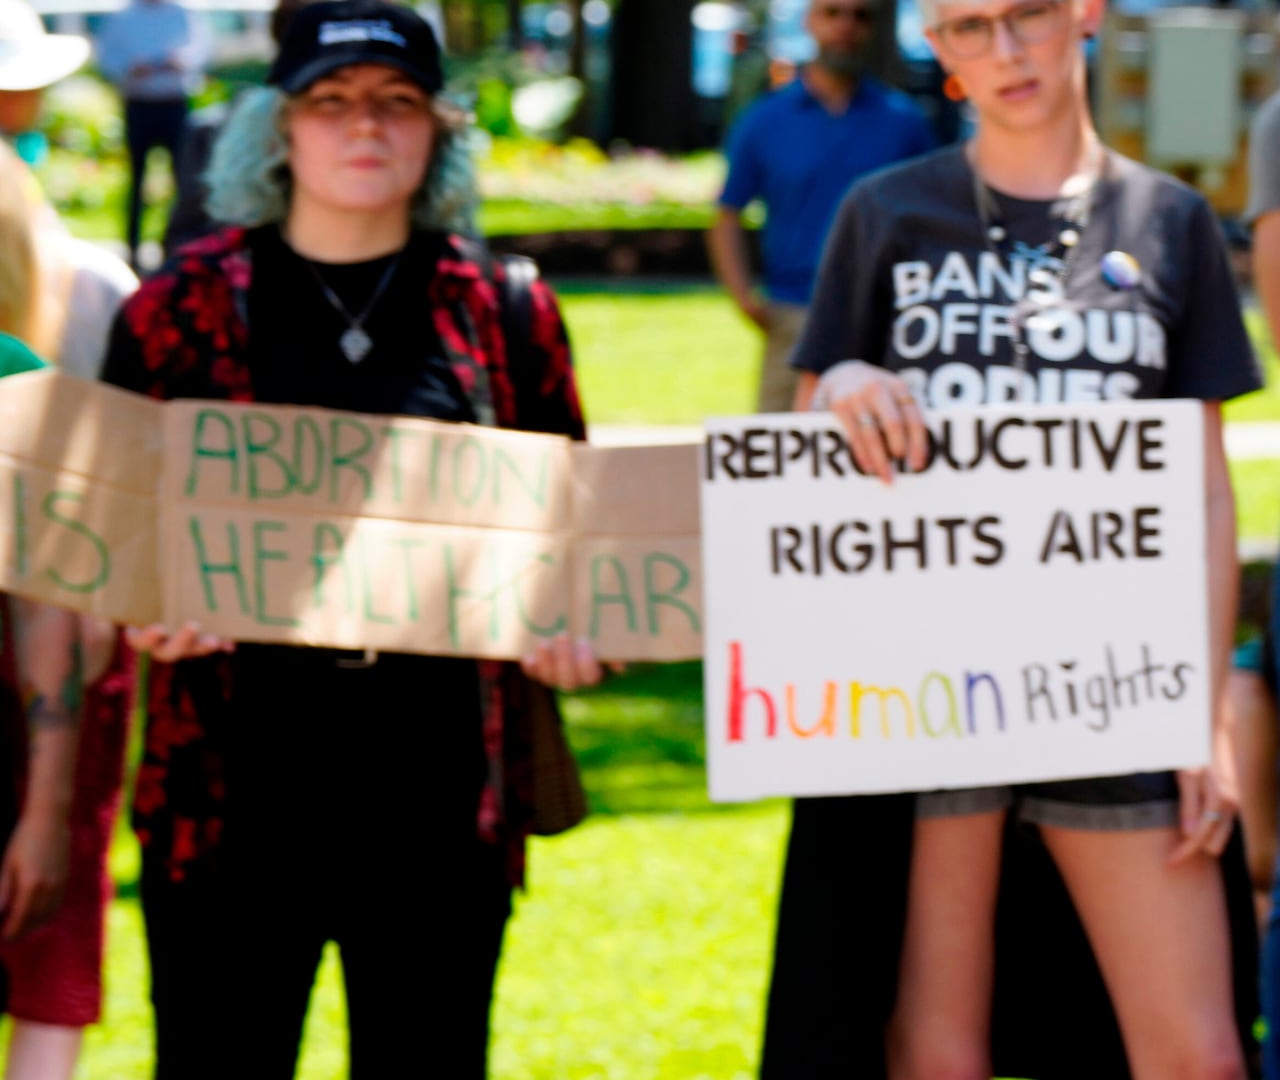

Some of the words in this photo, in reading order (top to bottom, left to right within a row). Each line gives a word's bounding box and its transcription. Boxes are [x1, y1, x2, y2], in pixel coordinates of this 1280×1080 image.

[892, 251, 1066, 311] BANS
[893, 302, 1018, 360] OFF
[1027, 307, 1166, 369] OUR
[185, 409, 549, 508] ABORTION
[12, 469, 111, 594] IS
[771, 517, 1003, 576] RIGHTS
[1040, 506, 1162, 565] ARE
[188, 517, 702, 649] HEALTHCAR
[726, 641, 1005, 744] human
[1021, 643, 1197, 732] Rights
